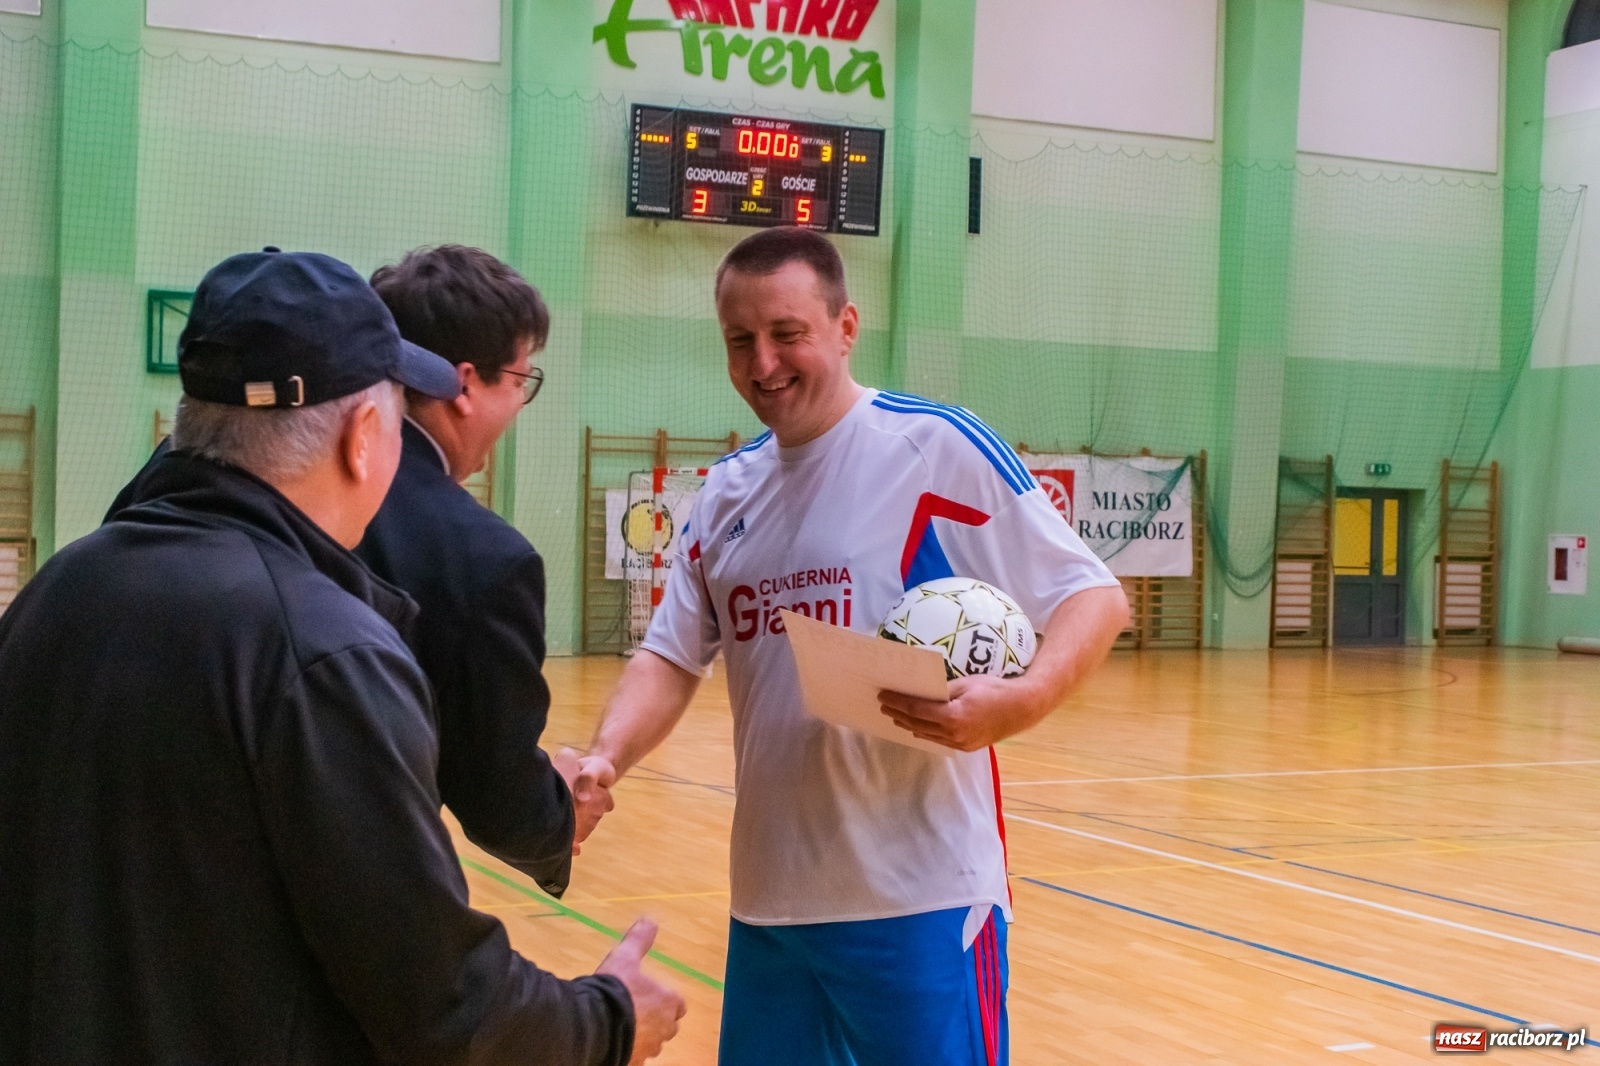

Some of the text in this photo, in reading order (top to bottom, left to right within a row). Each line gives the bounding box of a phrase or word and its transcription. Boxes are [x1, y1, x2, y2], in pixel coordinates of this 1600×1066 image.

[593, 0, 885, 99] Arena
[732, 117, 751, 126] CZAS
[756, 119, 775, 129] CZAS
[775, 121, 791, 130] GRY
[686, 132, 697, 149] 5
[821, 145, 832, 162] 3
[686, 167, 749, 185] GOSPODARZE
[782, 174, 816, 192] GOŚCIE
[752, 180, 763, 196] 2
[693, 189, 708, 213] 3
[797, 199, 810, 222] 5
[1092, 490, 1172, 512] MIASTO
[759, 566, 852, 595] CUKIERNIA
